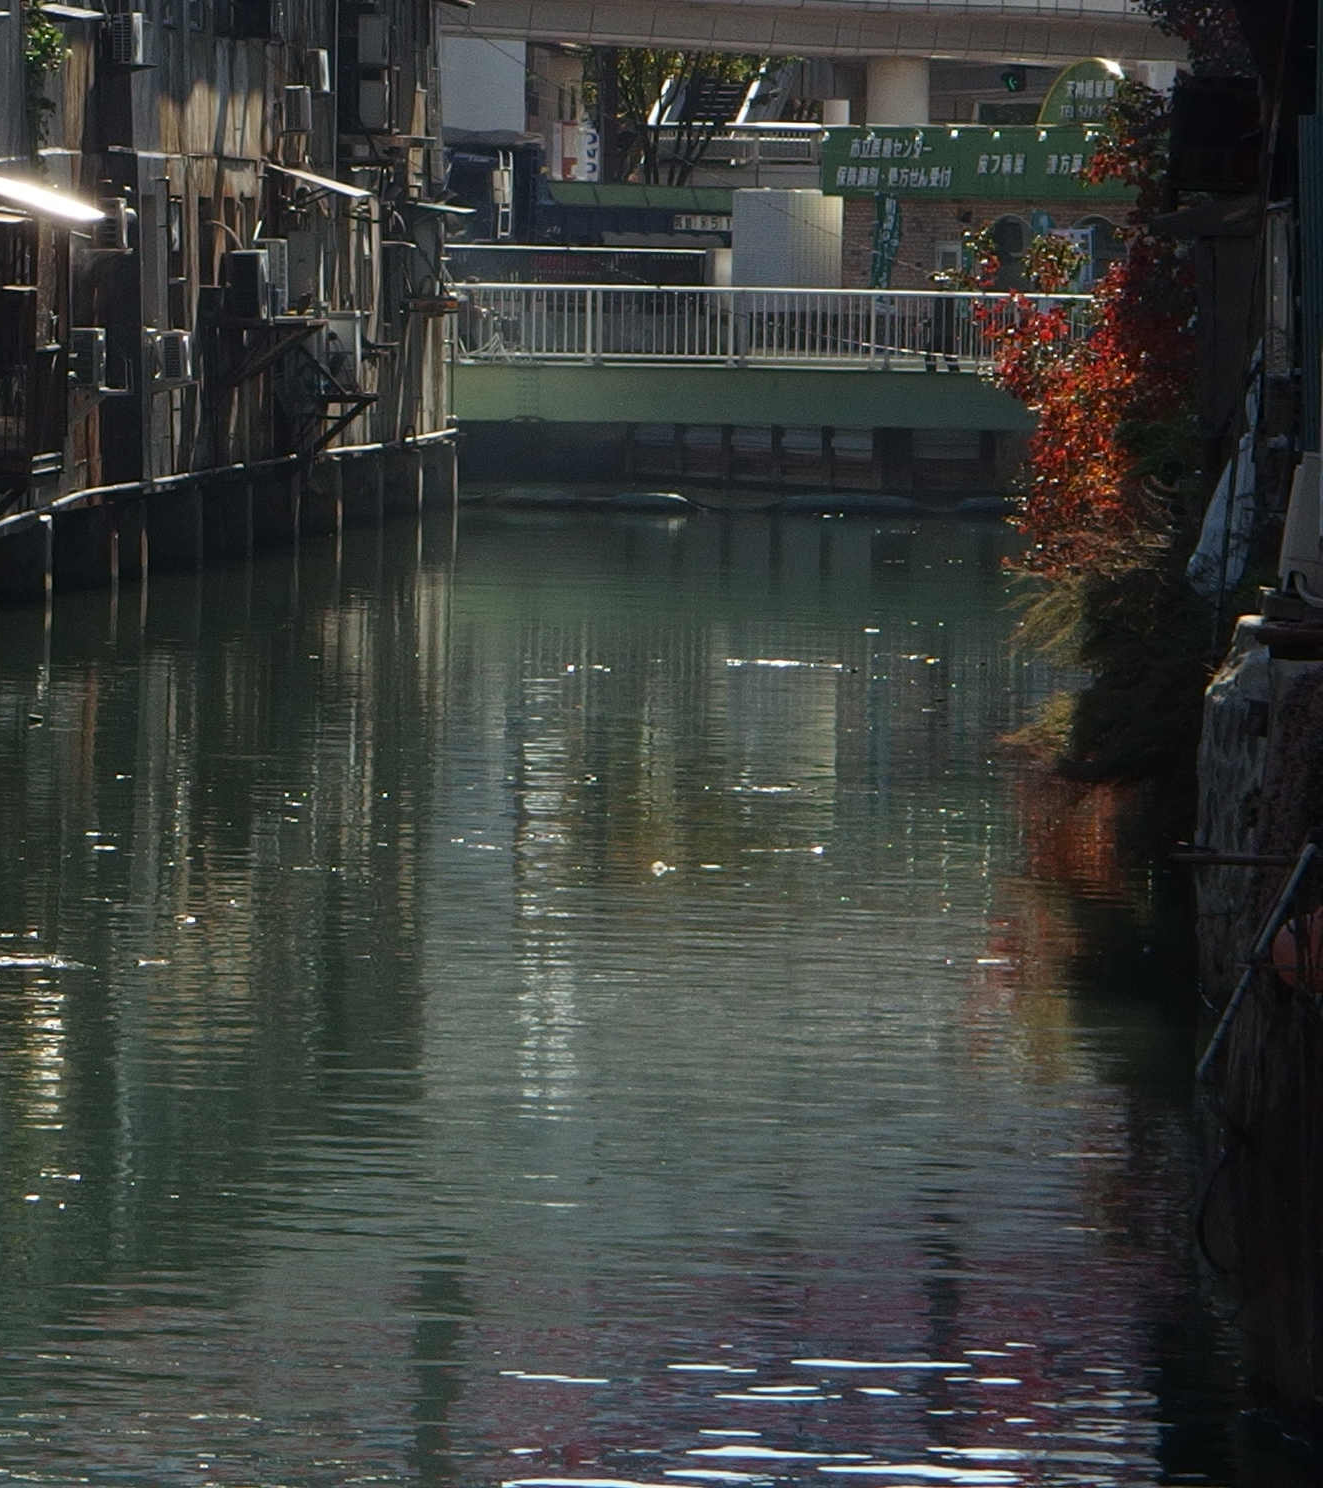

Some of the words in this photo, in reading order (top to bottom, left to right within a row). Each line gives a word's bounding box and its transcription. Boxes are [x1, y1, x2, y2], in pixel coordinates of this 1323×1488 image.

[849, 138, 933, 159] 市立医療センター
[836, 165, 952, 188] 保険調剤・処方せん受付
